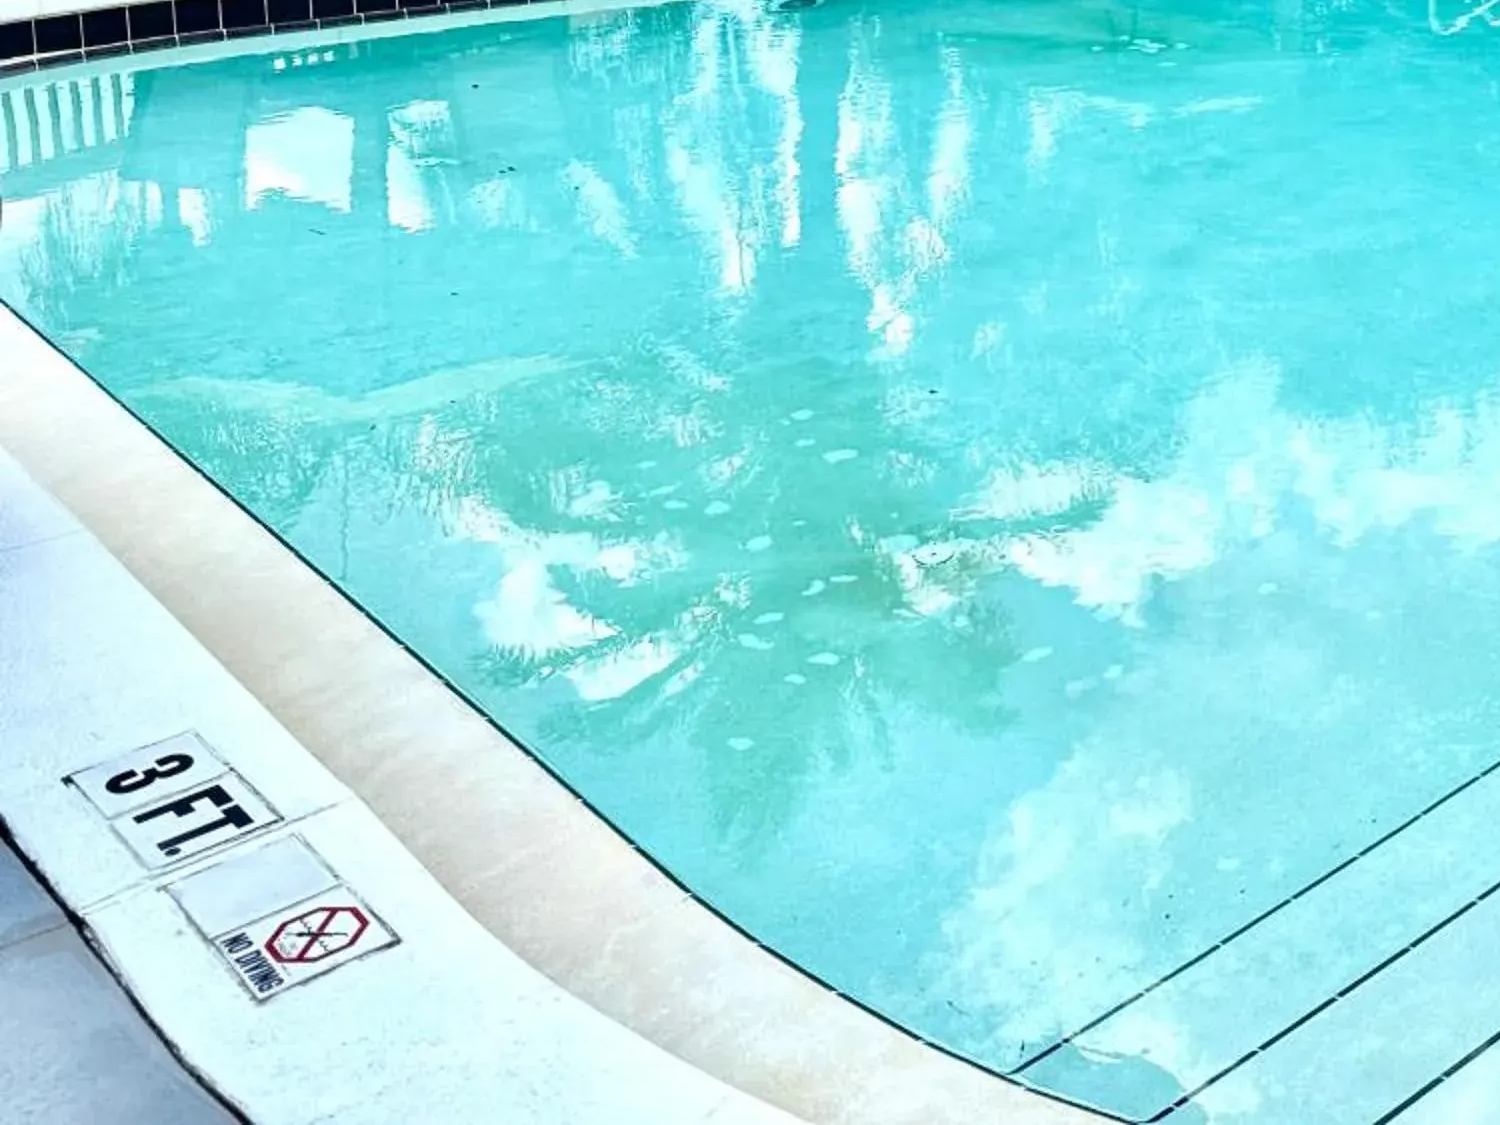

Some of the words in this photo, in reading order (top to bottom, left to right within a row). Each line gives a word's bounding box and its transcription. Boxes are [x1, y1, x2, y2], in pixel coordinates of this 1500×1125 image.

[105, 753, 194, 794] 3
[132, 784, 255, 857] FT.
[220, 932, 254, 953] NO
[234, 949, 285, 993] DIVING
